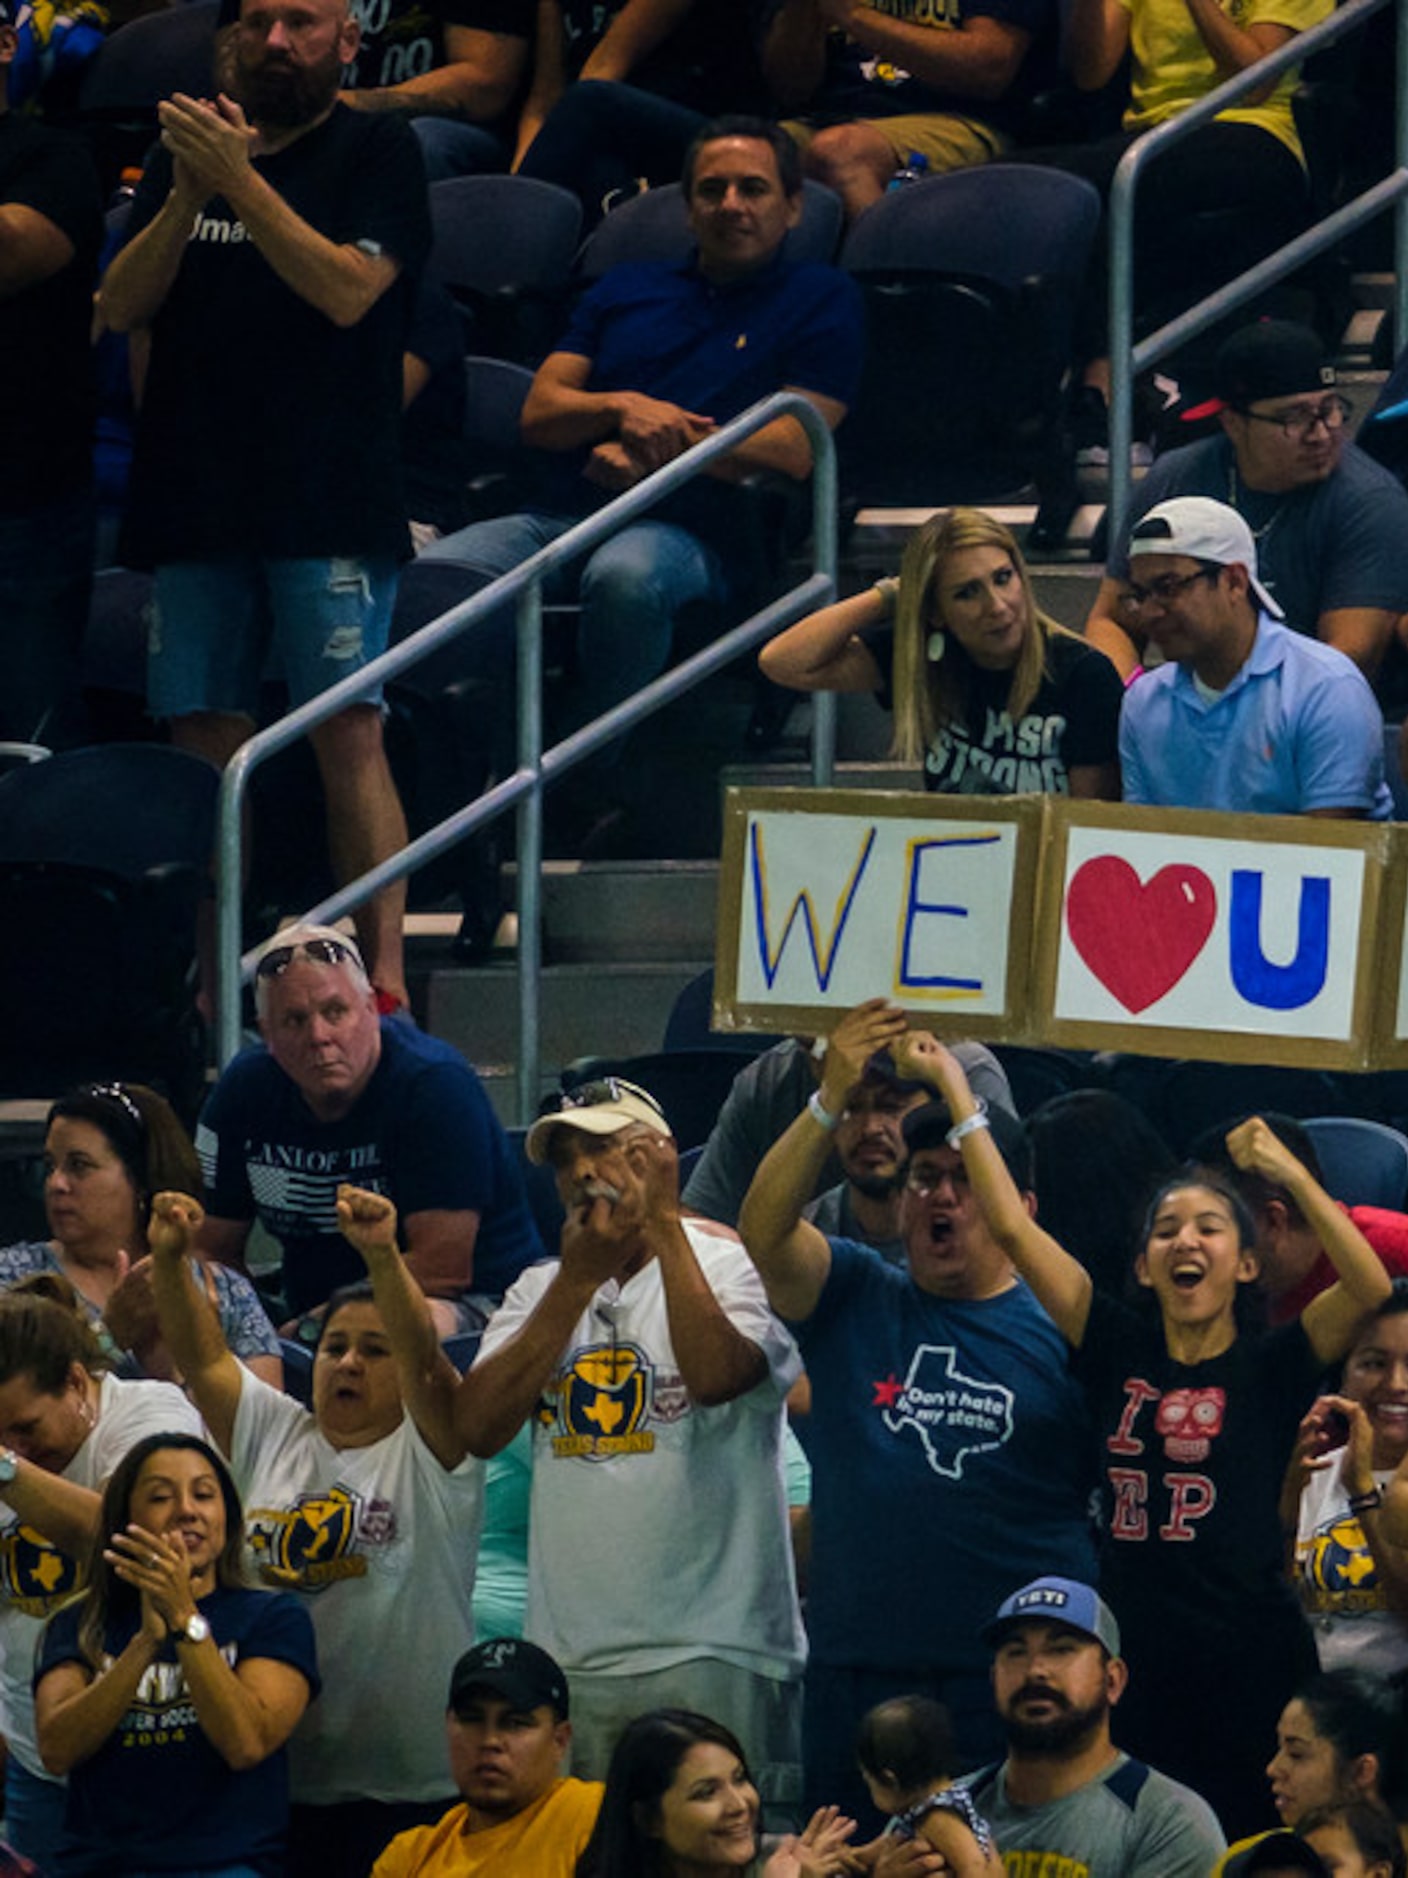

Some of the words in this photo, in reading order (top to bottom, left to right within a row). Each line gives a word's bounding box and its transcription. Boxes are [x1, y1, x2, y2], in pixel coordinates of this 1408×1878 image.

[752, 820, 1001, 999] WE
[1229, 868, 1331, 1011] U
[907, 1386, 957, 1407] Don't
[957, 1391, 1005, 1416] hate
[914, 1408, 945, 1426] my
[946, 1410, 1001, 1434] state.
[1106, 1377, 1162, 1456] I
[1017, 1589, 1066, 1608] YETI
[121, 1727, 187, 1749] 2004
